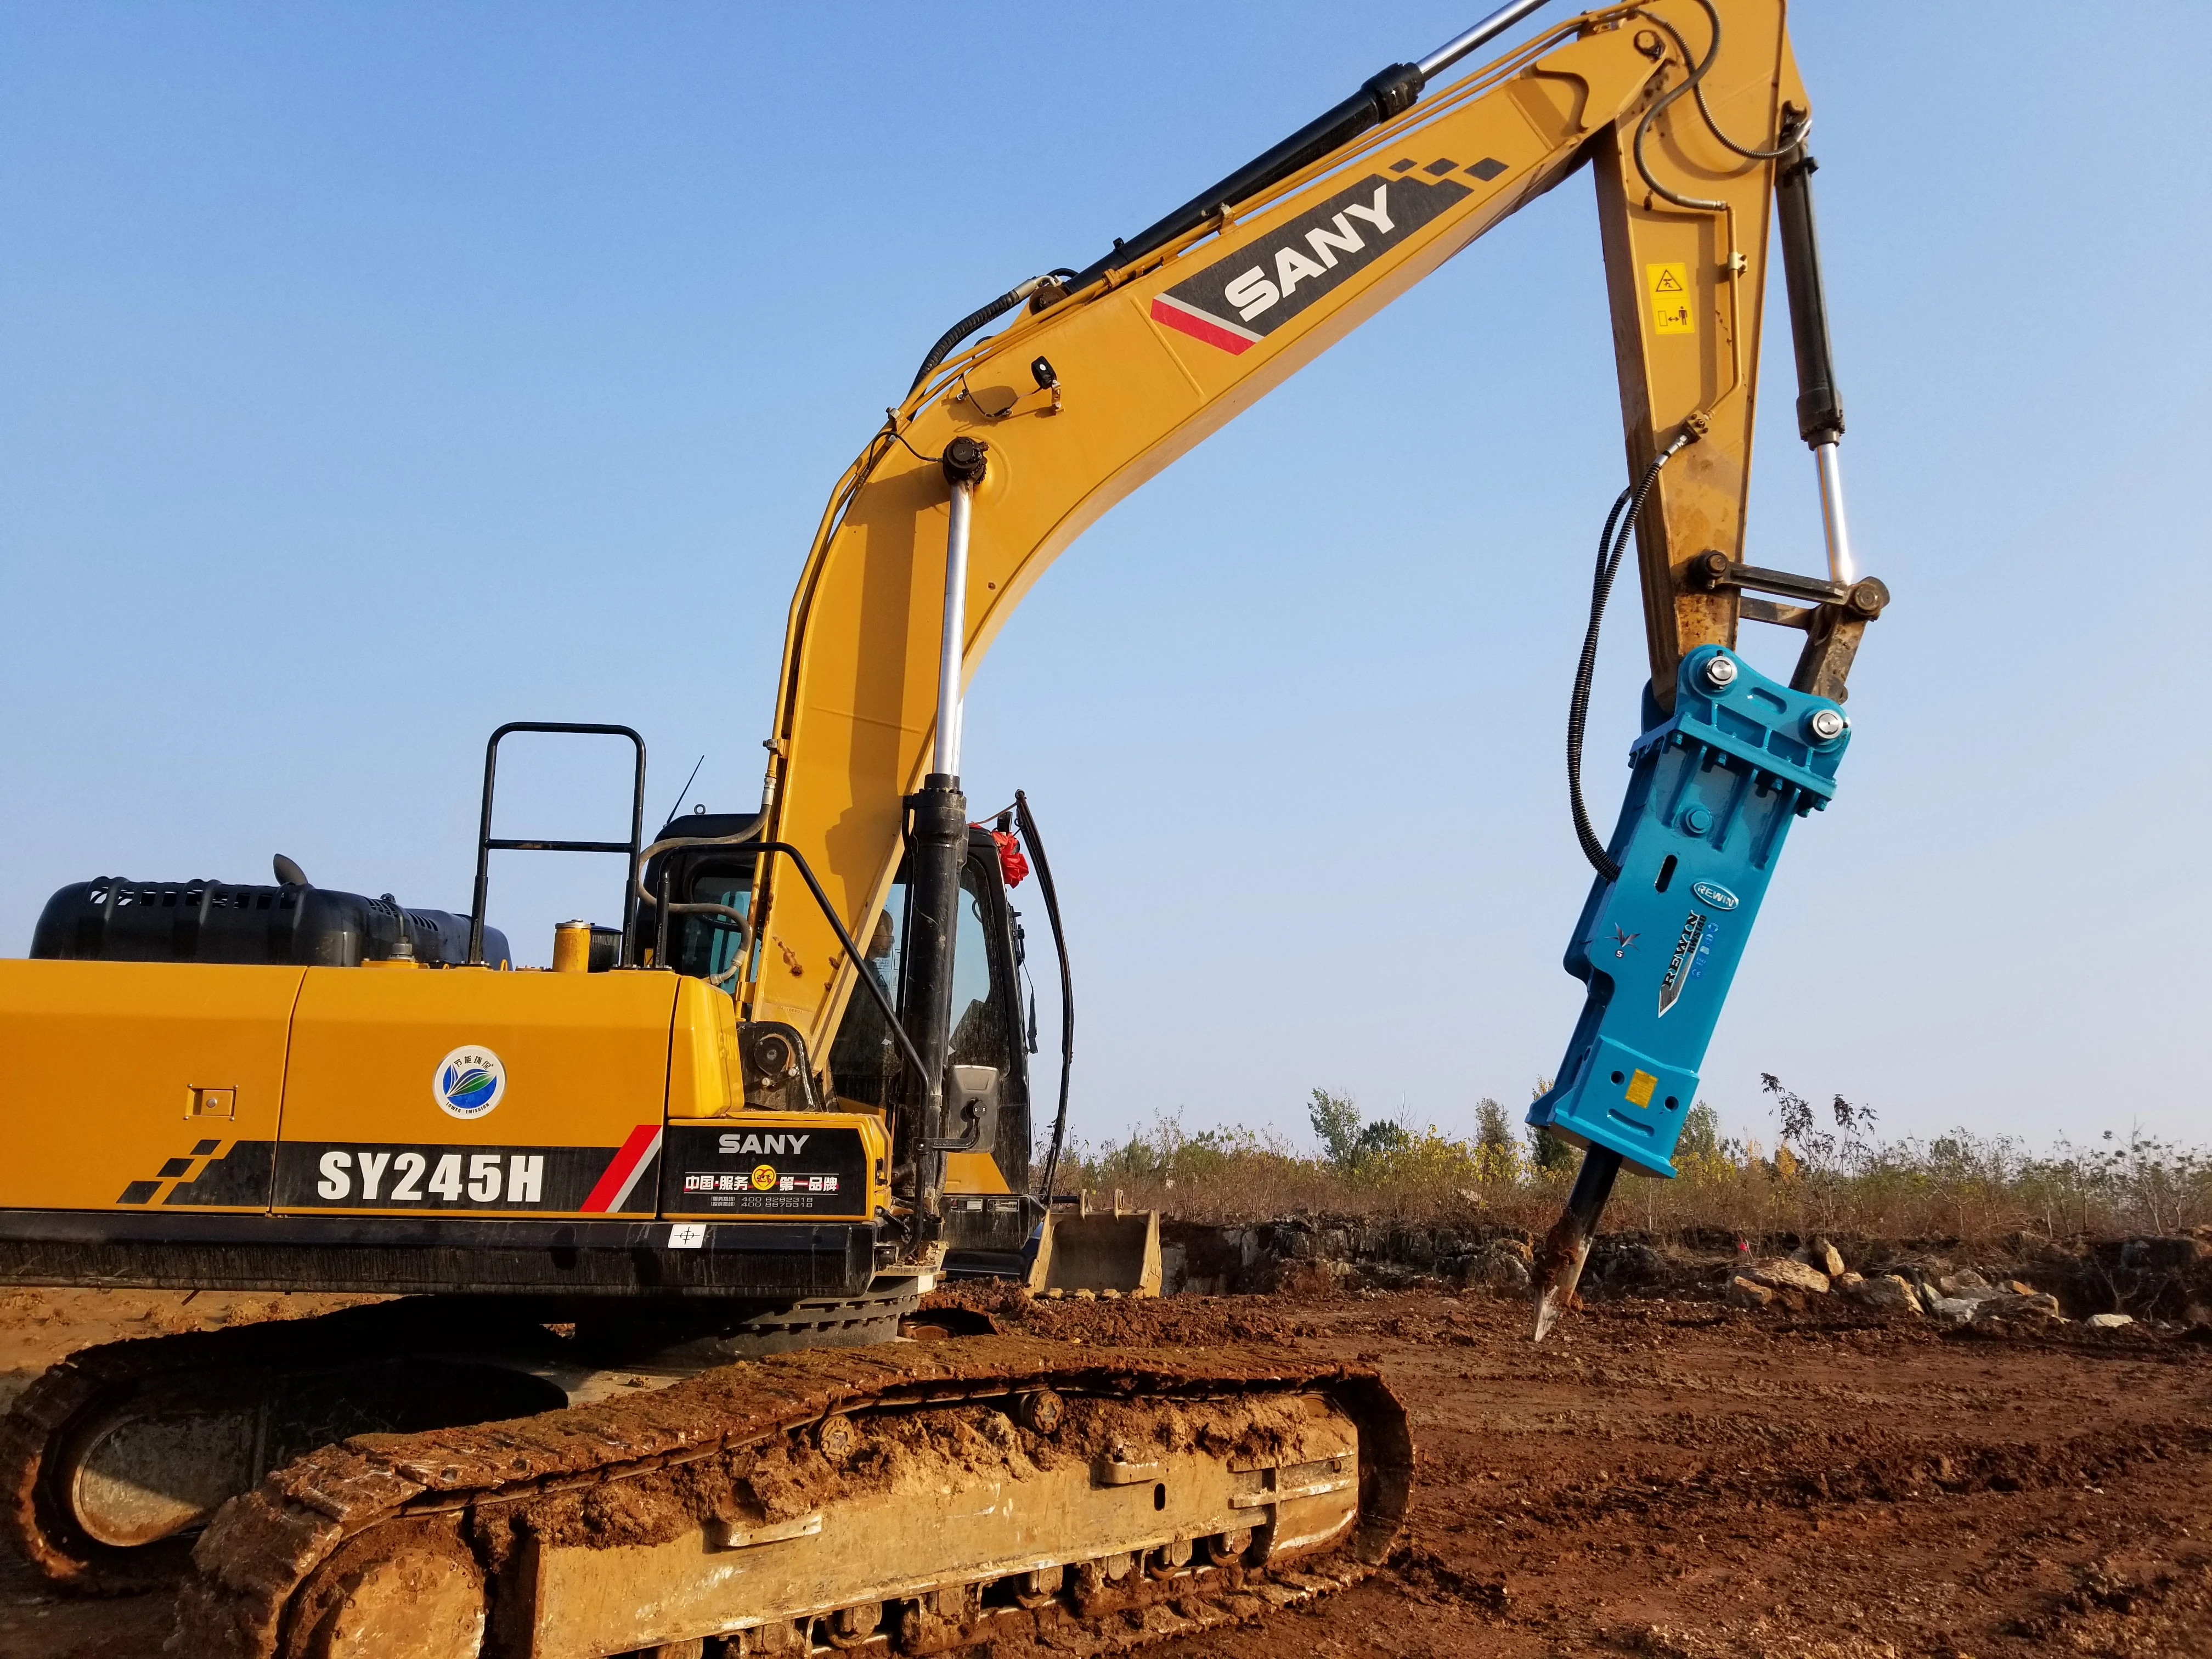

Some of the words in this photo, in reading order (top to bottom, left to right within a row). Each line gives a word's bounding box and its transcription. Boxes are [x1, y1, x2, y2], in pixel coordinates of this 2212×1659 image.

[1224, 184, 1395, 323] SANY
[1697, 885, 1735, 907] REWIN
[1661, 909, 1700, 991] REWIN
[454, 1056, 492, 1070] 节能环保
[446, 1102, 461, 1113] LOWER
[465, 1103, 489, 1114] EMISSION
[719, 1134, 810, 1154] SANY
[317, 1151, 544, 1203] SY245H
[780, 1177, 838, 1191] 第一品牌
